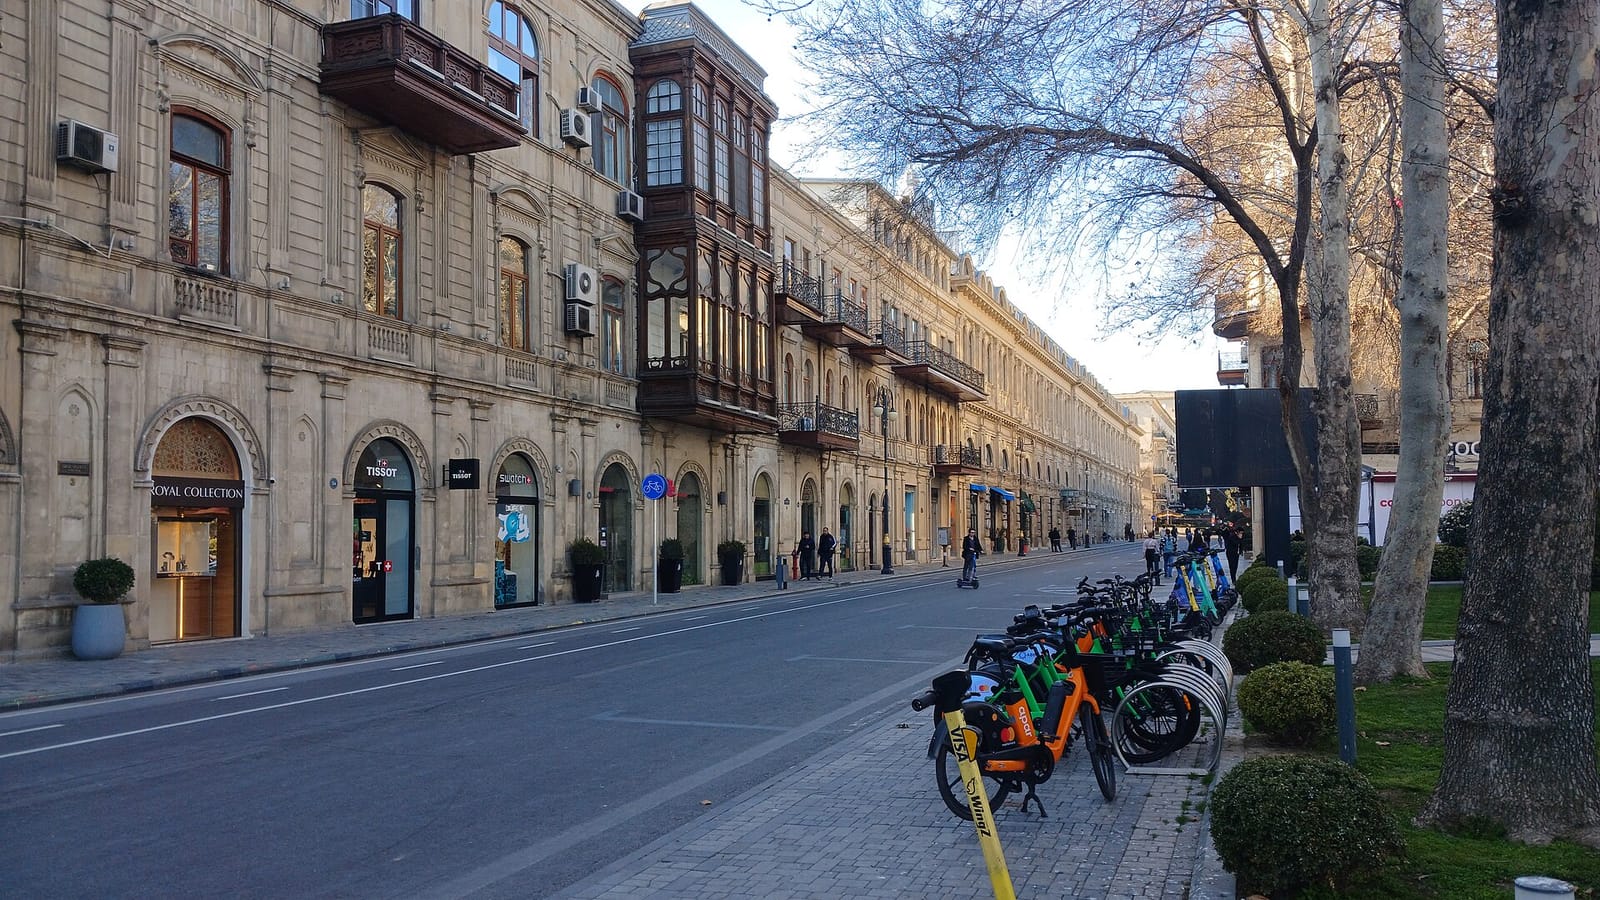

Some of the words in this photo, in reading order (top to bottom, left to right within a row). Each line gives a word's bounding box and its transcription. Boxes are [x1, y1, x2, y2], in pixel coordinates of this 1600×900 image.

[366, 466, 397, 477] TISSOT
[150, 485, 181, 497] ROYAL
[184, 486, 243, 499] COLLECTION
[950, 725, 969, 763] VISA
